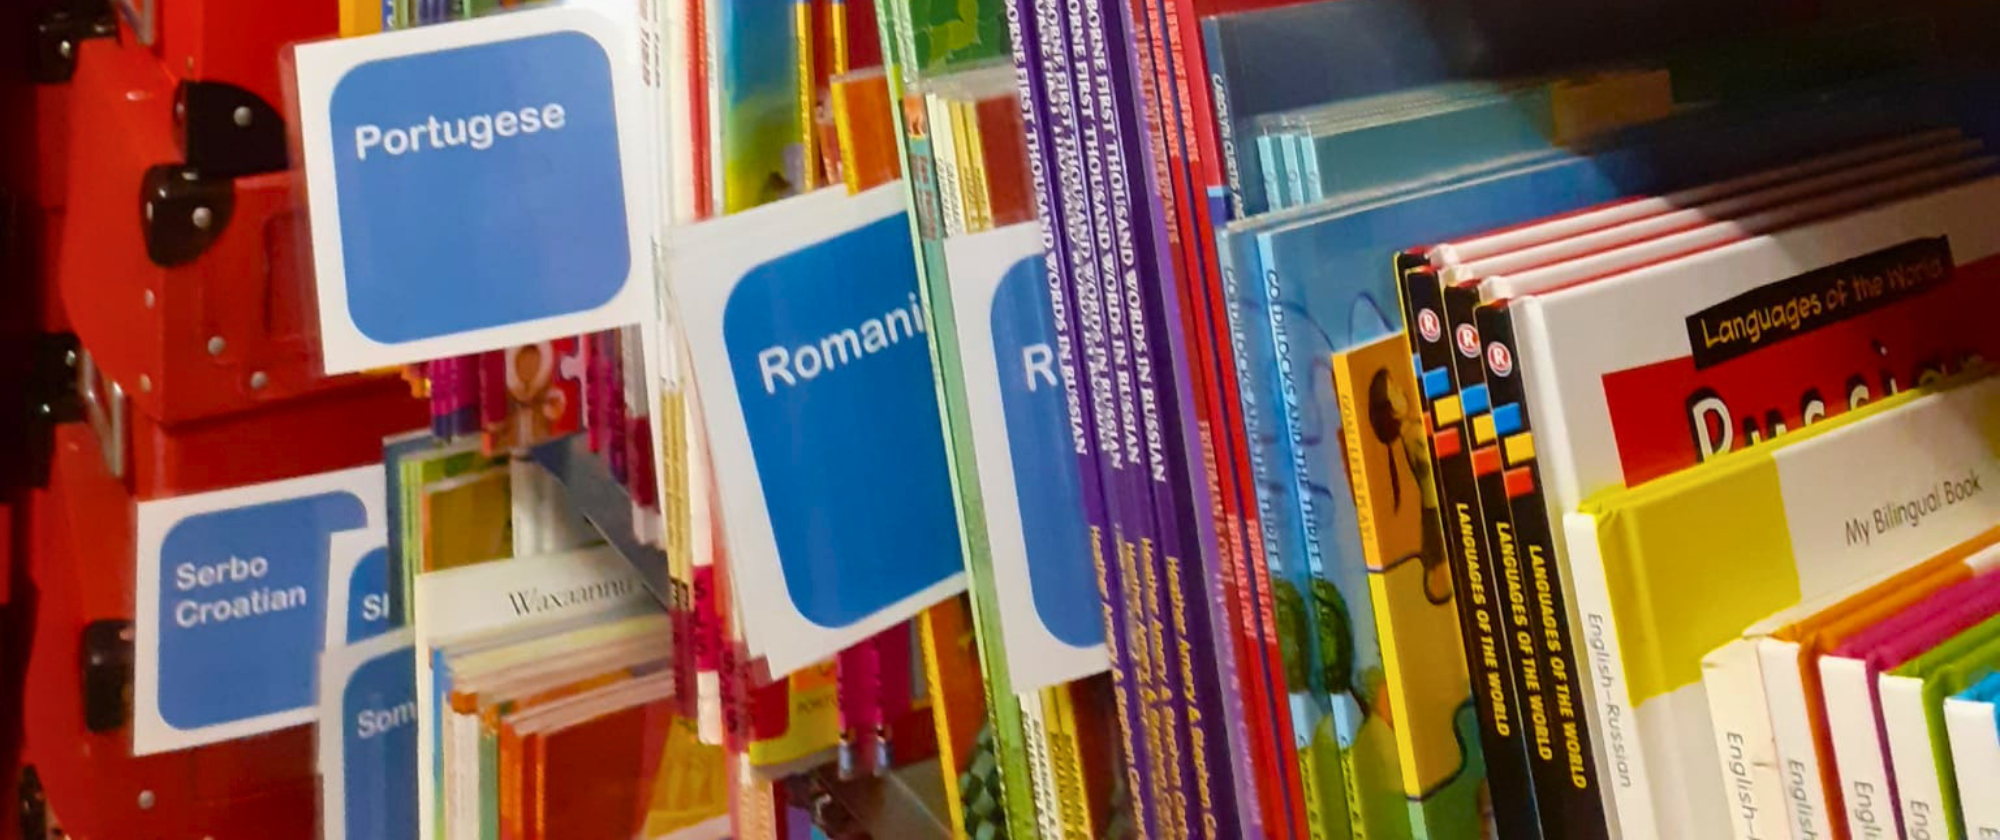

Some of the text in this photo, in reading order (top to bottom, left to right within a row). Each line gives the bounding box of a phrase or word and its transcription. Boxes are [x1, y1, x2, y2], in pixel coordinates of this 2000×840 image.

[355, 102, 566, 161] Portugese
[1016, 68, 1036, 124] FIRST
[1075, 61, 1096, 120] FIRST
[1095, 75, 1116, 134] FIRST
[1212, 73, 1232, 139] CAROLYN
[1223, 141, 1241, 191] CURTIS
[1026, 127, 1055, 248] THOUSAND
[1084, 124, 1111, 249] THOUSAND
[1104, 138, 1135, 266] THOUSAND
[1046, 251, 1068, 332] WORDS
[1102, 253, 1123, 335] WORDS
[1125, 269, 1147, 352] WORDS
[1701, 256, 1944, 349] Languages of the World
[758, 291, 925, 395] Romani
[1057, 335, 1072, 359] IN
[1112, 339, 1128, 365] IN
[1136, 357, 1152, 383] IN
[1061, 365, 1087, 455] RUSSIAN
[1117, 371, 1141, 464] RUSSIAN
[1141, 388, 1166, 482] RUSSIAN
[1267, 269, 1297, 396] GOLDILOCKS
[1286, 401, 1305, 445] AND
[1302, 499, 1323, 565] THREE
[1845, 468, 1983, 546] My Bilingual Book
[175, 585, 306, 628] Croatian
[176, 555, 269, 591] Serbo
[1166, 557, 1187, 635] Heather
[1456, 503, 1510, 737] LANGUAGES OF THE WORLD
[1496, 521, 1552, 761] LANGUAGES OF THE WORLD
[1529, 545, 1587, 789] LANGUAGES OF THE WORLD
